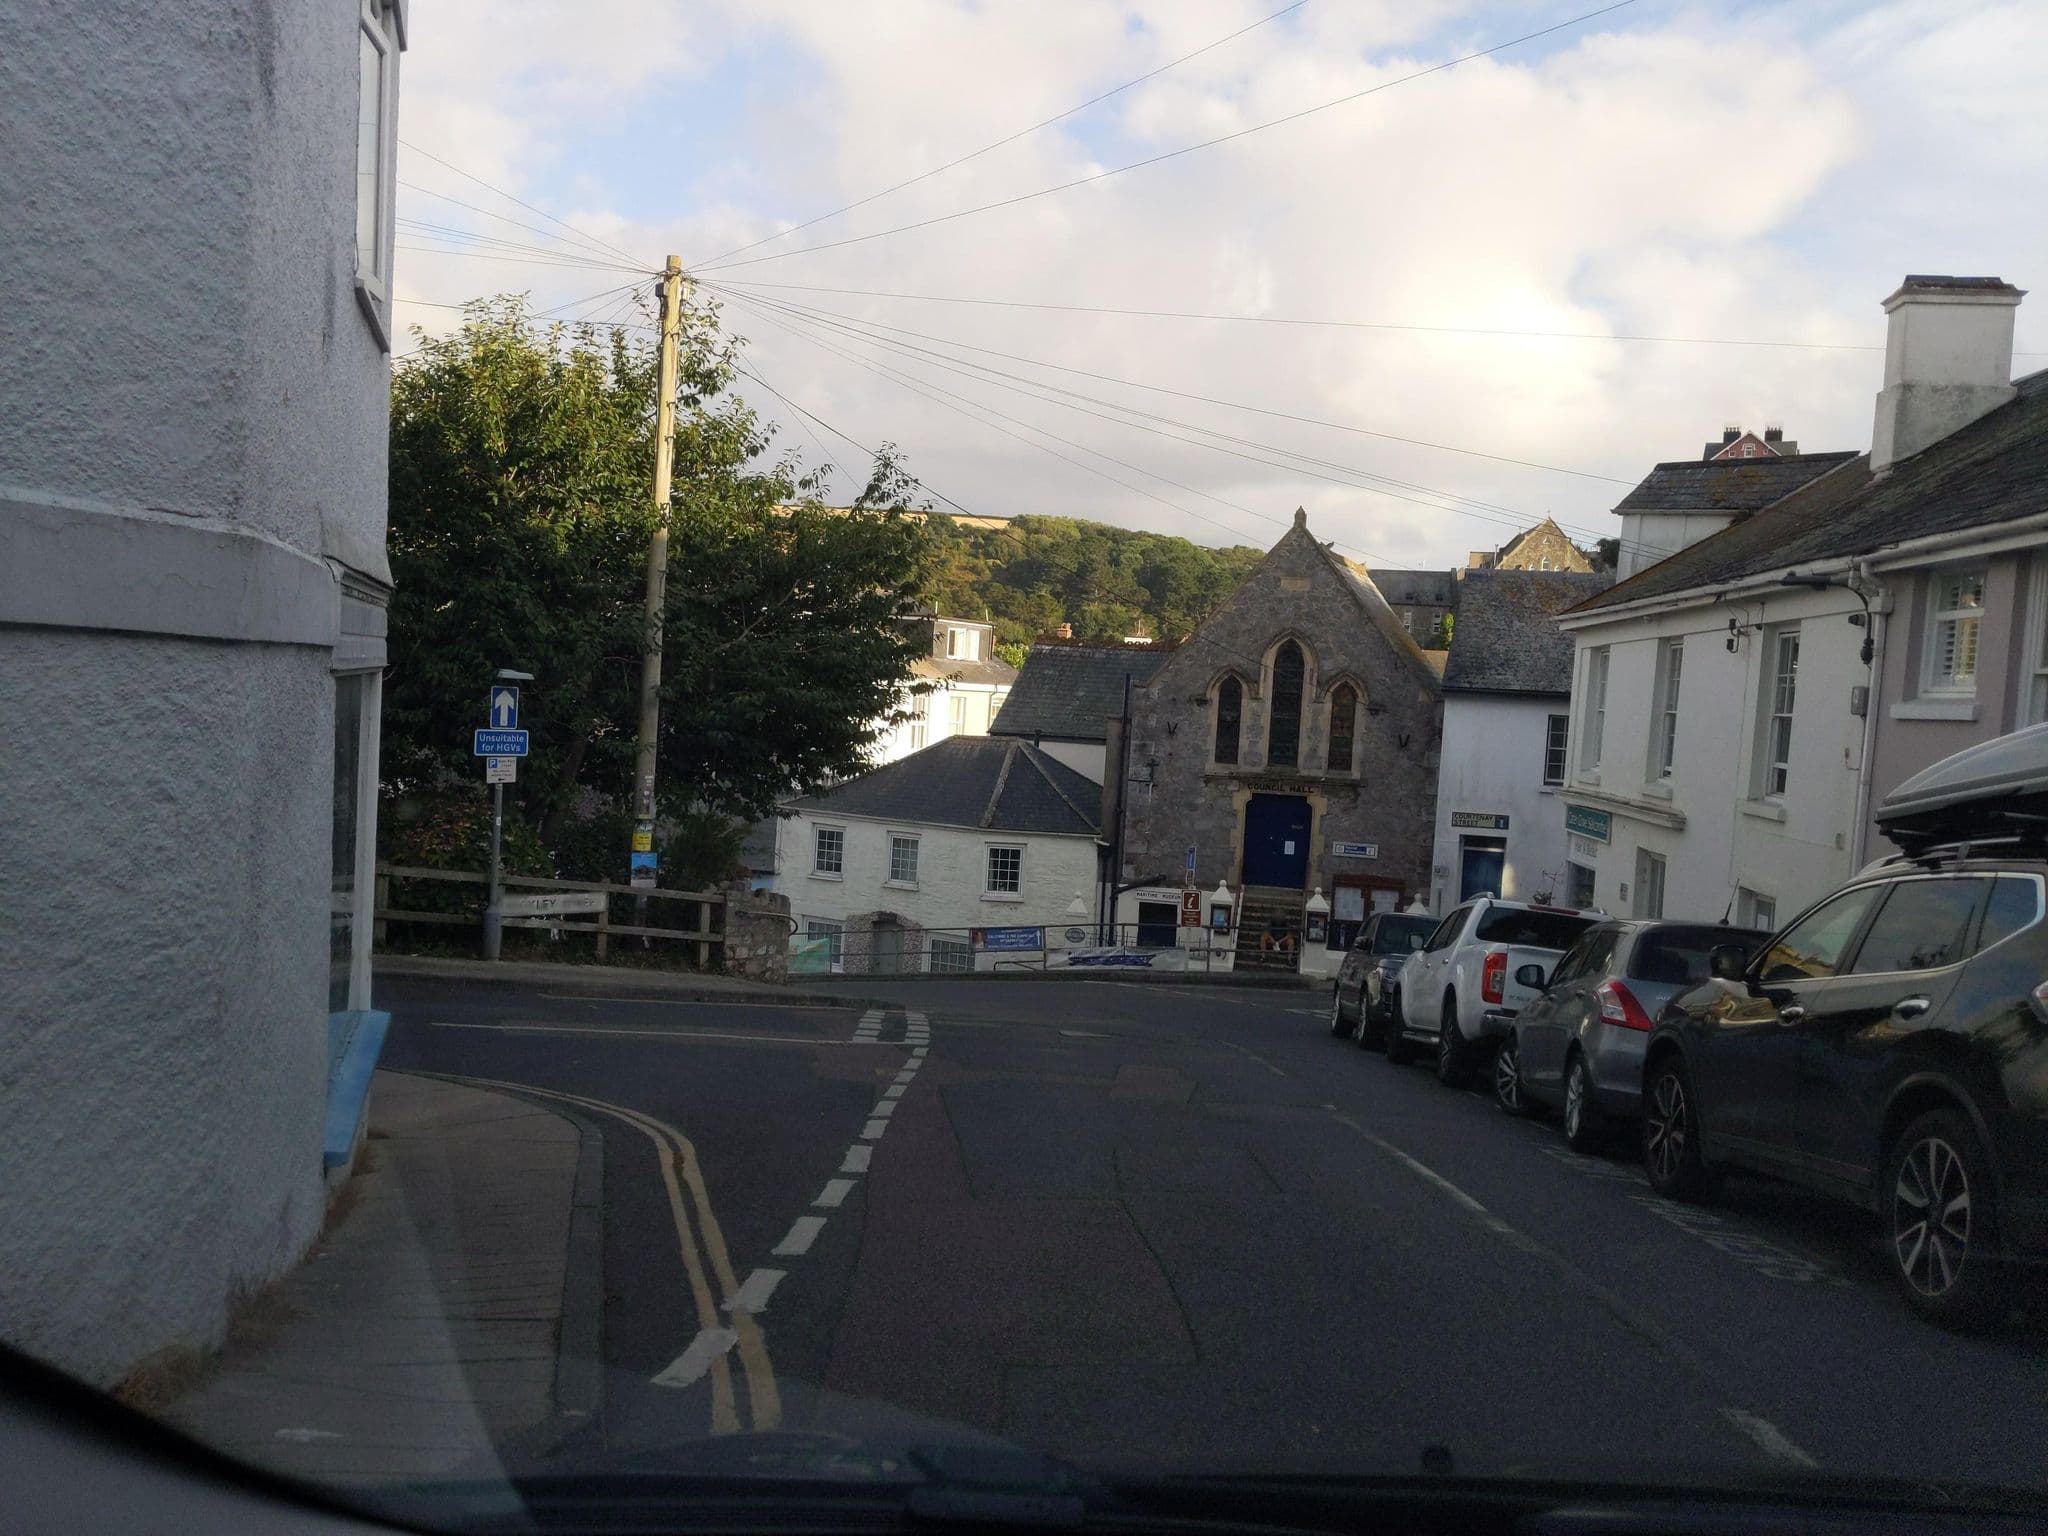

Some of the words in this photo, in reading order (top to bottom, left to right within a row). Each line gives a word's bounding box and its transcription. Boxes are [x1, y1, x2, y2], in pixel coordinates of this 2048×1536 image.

[479, 733, 525, 742] Unsuitable
[481, 743, 494, 751] for
[496, 743, 521, 752] HGVs
[1247, 783, 1285, 792] COUNCIL
[1289, 784, 1314, 793] HALL
[1454, 813, 1493, 821] COURTENAY
